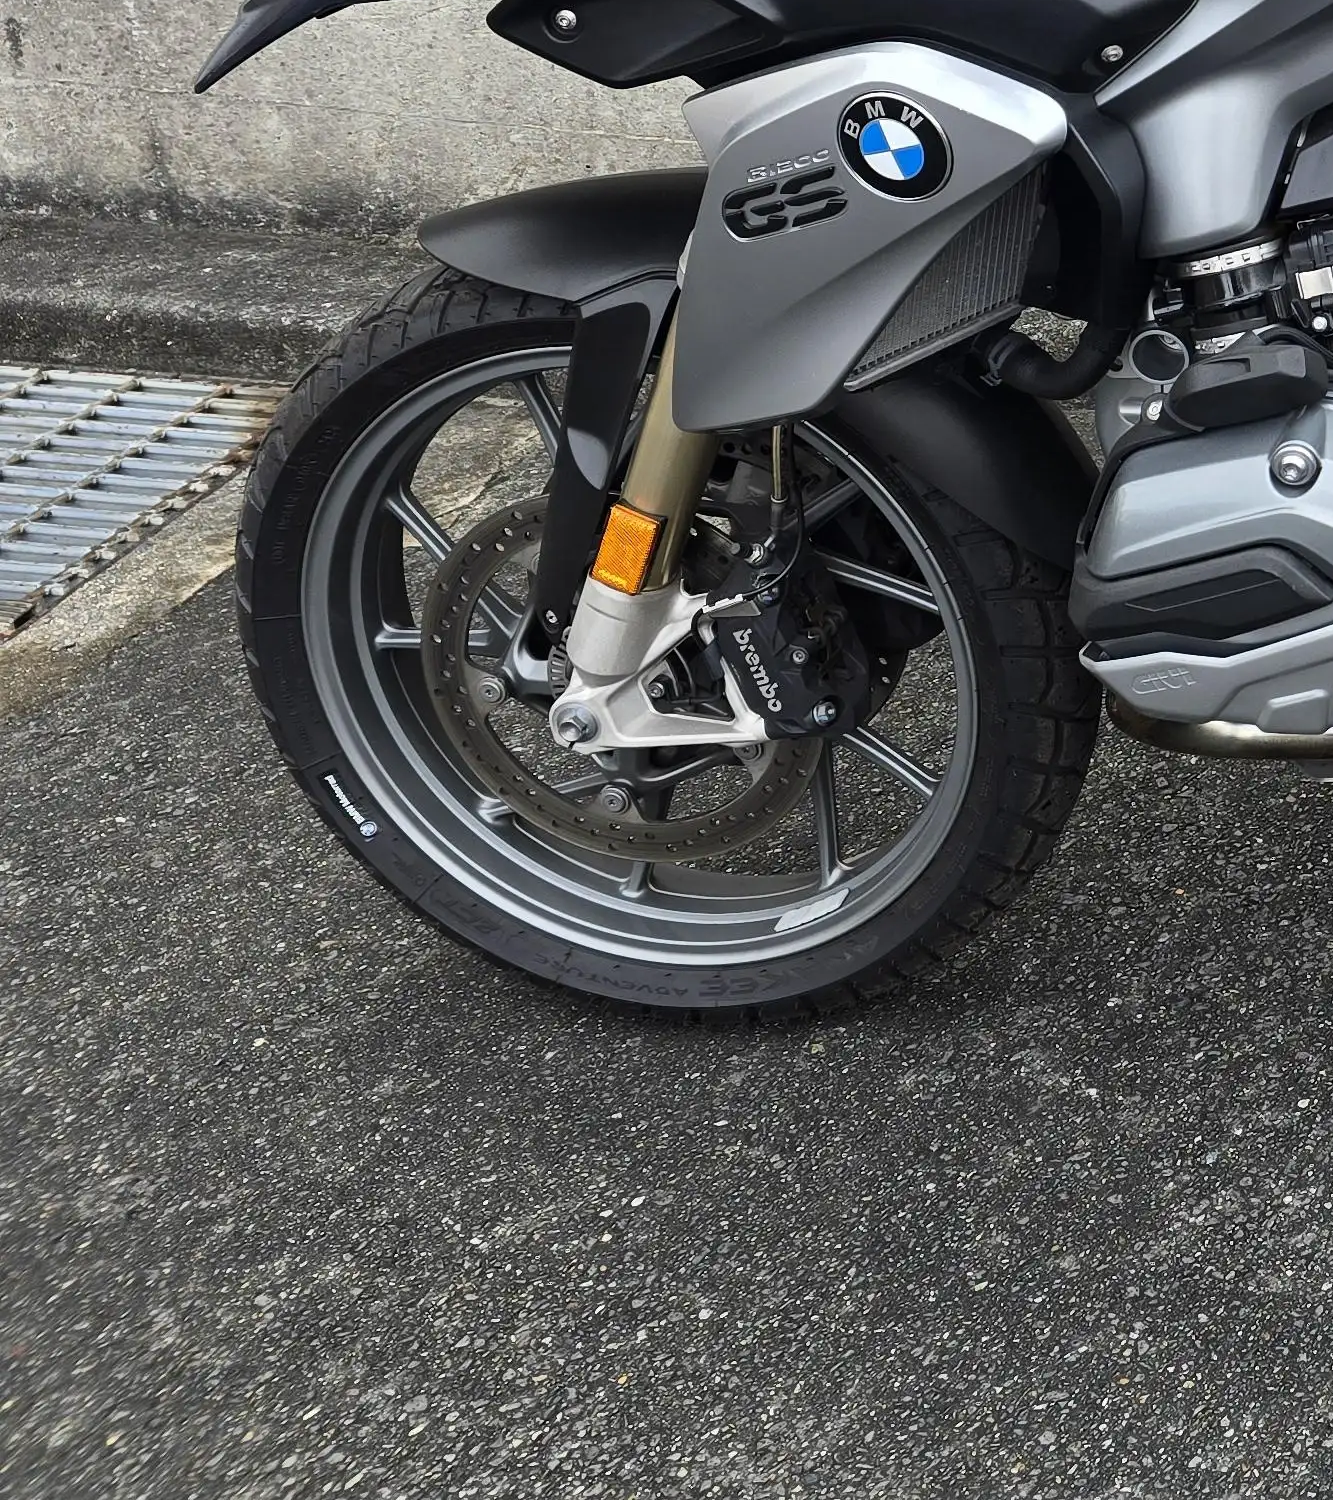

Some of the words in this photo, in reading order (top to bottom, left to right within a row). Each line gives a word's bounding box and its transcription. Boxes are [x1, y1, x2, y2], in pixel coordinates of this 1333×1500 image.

[844, 100, 924, 139] BMW
[722, 165, 848, 241] GS
[733, 628, 782, 712] brembo
